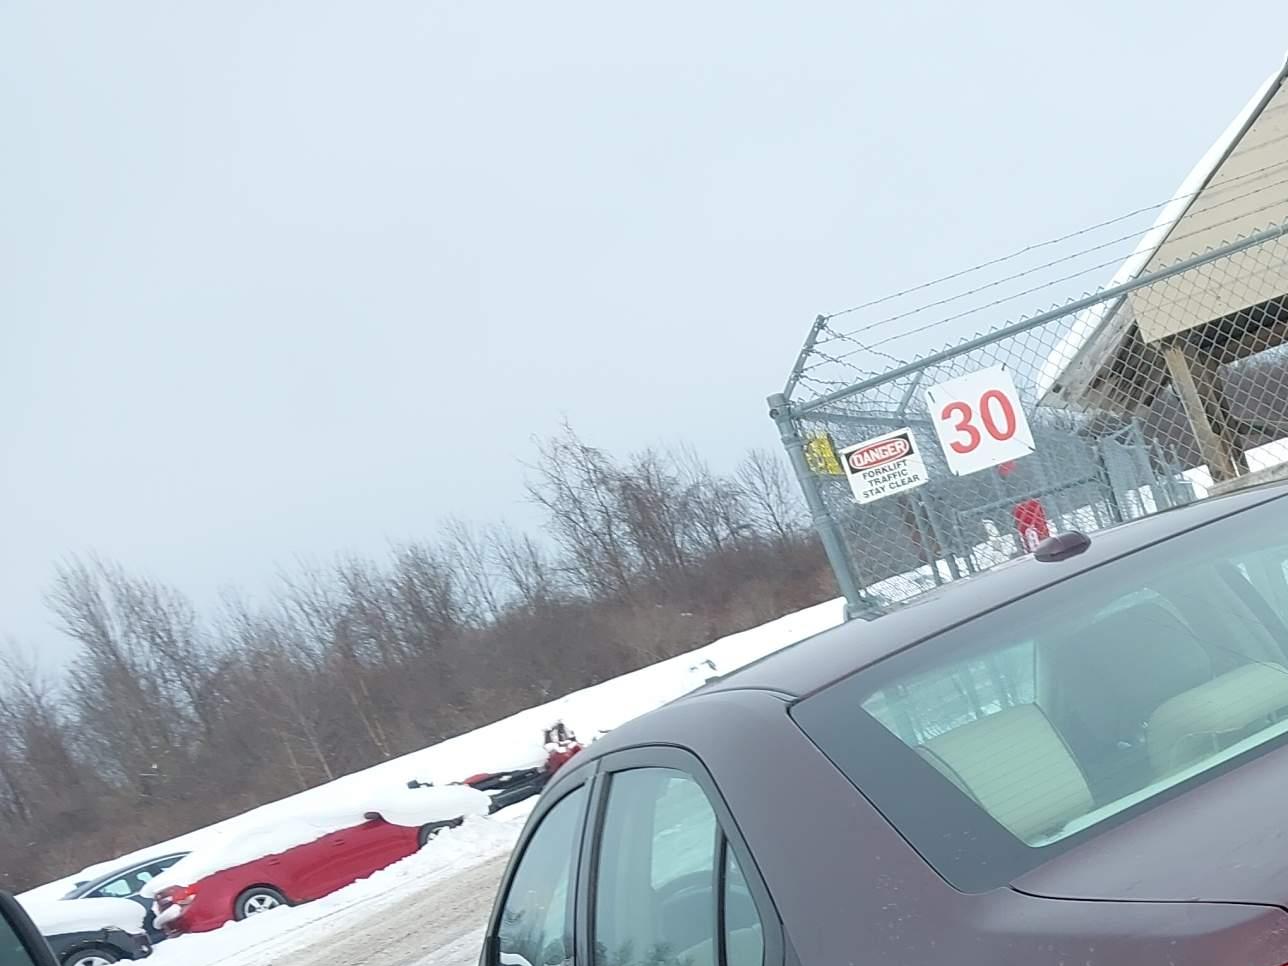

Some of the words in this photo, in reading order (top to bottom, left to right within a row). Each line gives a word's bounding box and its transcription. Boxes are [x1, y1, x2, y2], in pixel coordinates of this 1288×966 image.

[941, 390, 1017, 454] 30
[853, 440, 905, 467] DANGER
[862, 459, 908, 480] FORKLIFT
[867, 469, 908, 487] TRAFFIC
[862, 486, 886, 498] STAY
[888, 474, 920, 490] CLEAR
